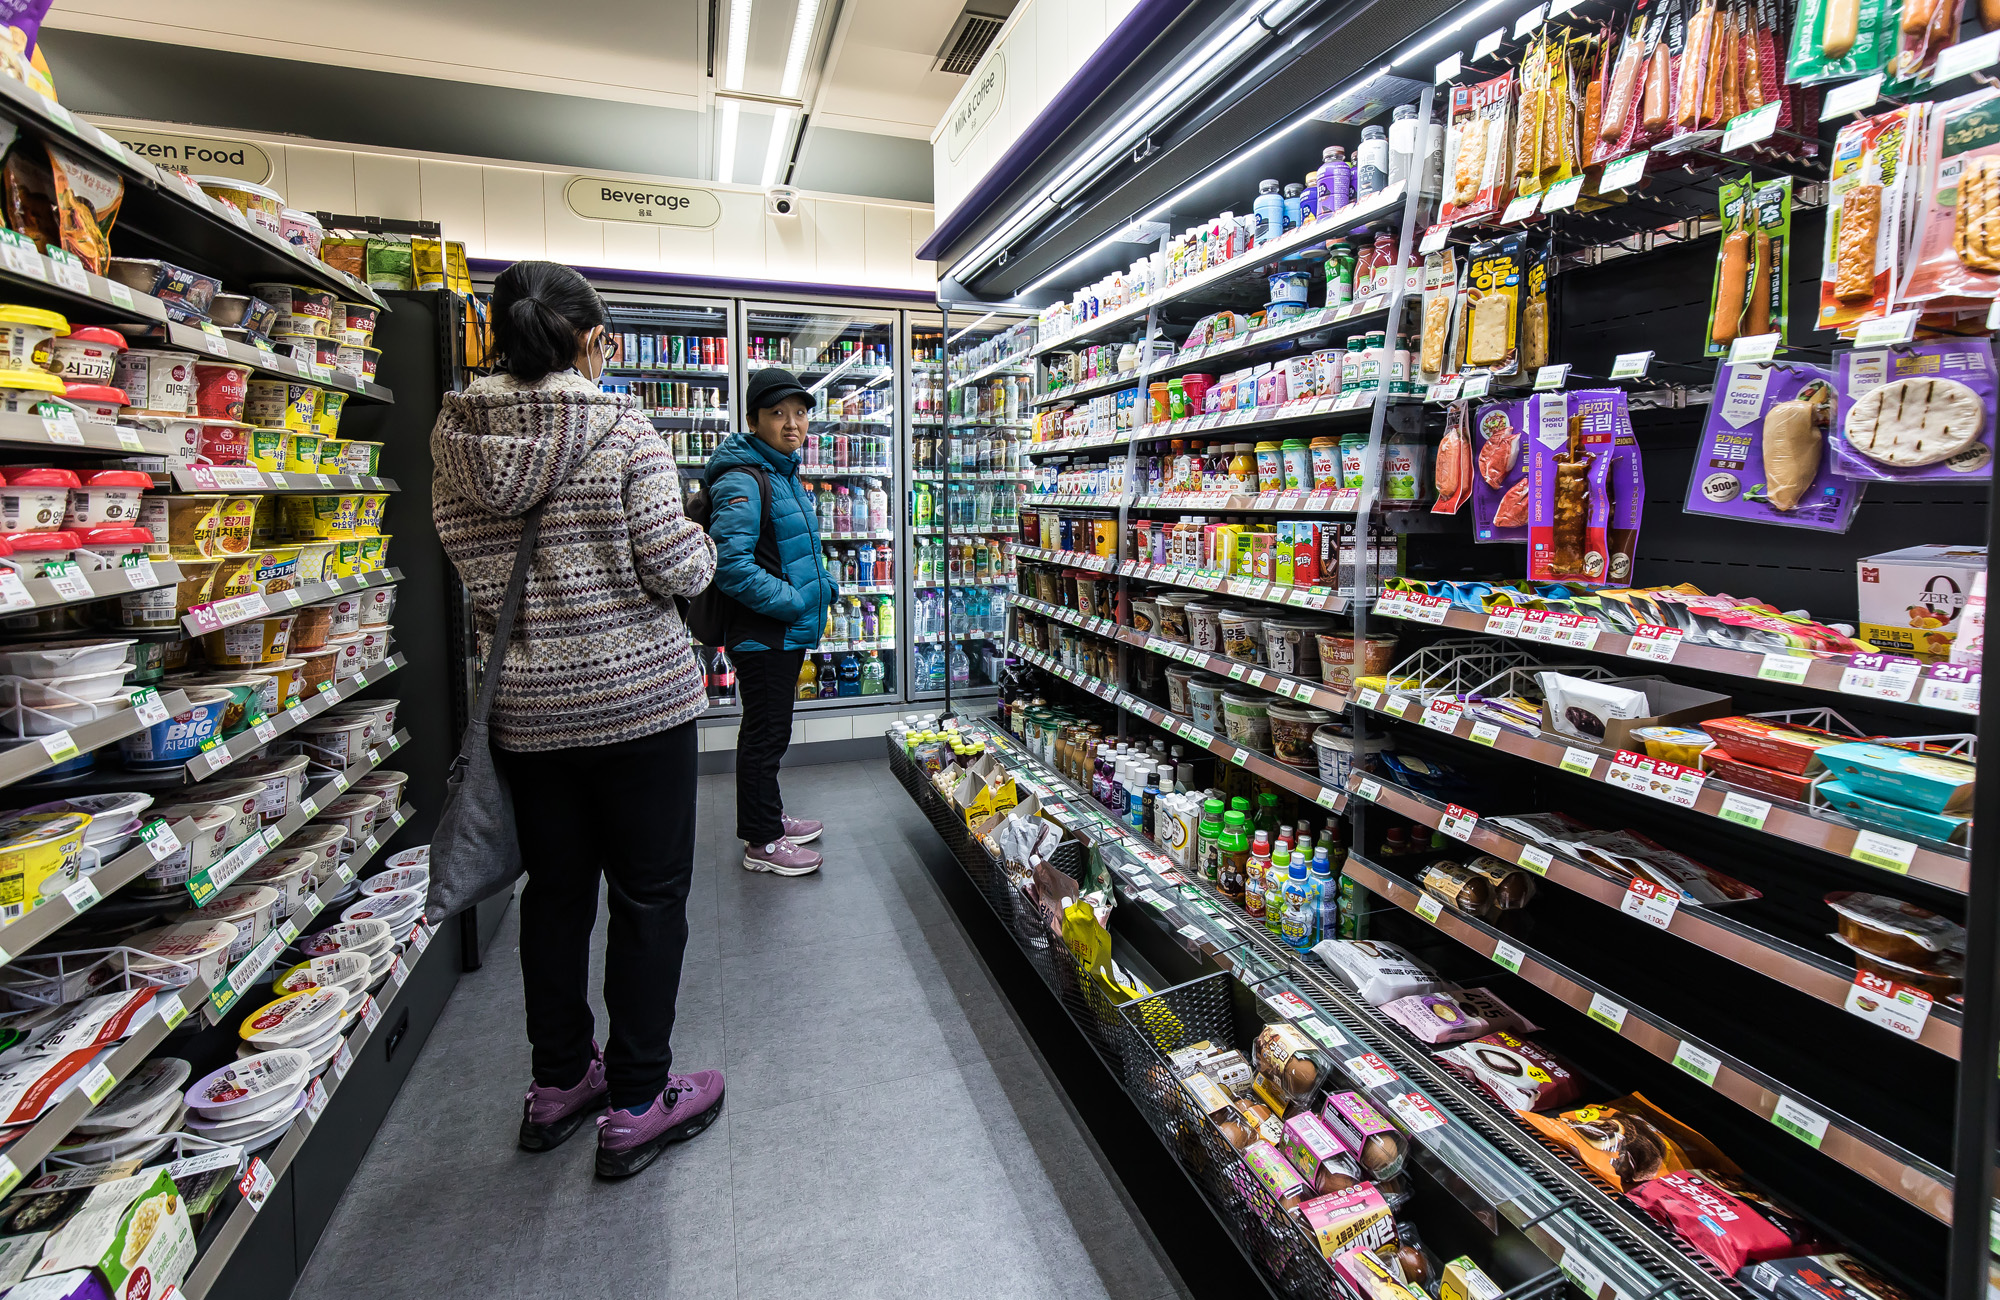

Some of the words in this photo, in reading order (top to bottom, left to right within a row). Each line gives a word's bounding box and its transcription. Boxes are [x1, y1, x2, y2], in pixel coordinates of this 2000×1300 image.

[1472, 78, 1508, 112] BIG
[954, 109, 967, 137] Milk
[972, 71, 995, 112] Coffee
[118, 140, 178, 159] ozen
[184, 145, 245, 166] Food
[601, 187, 690, 210] Beverage
[638, 208, 653, 217] 음료
[180, 272, 194, 284] BIG
[1470, 256, 1514, 290] 탱글
[173, 310, 186, 322] BIG
[1942, 352, 1987, 371] 득템
[65, 361, 111, 379] 쇠고기죽
[1730, 391, 1760, 399] CHOICE
[1748, 398, 1756, 406] U
[1541, 416, 1566, 424] CHOICE
[1557, 421, 1563, 429] U
[1715, 433, 1753, 446] 닭가슴살
[1712, 443, 1750, 461] 득템
[1314, 463, 1332, 473] live
[192, 467, 213, 483] 2+2
[123, 556, 136, 568] 1+1
[46, 564, 64, 578] 1+1
[258, 569, 285, 580] 오뚜기
[1383, 590, 1396, 599] 2+1
[1409, 592, 1421, 602] 2+1
[1424, 596, 1438, 606] 2+1
[194, 608, 216, 624] 2+2
[1494, 606, 1510, 616] 2+1
[1528, 611, 1543, 621] 2+1
[1561, 615, 1577, 625] 2+1
[1638, 624, 1660, 637] 2+1
[1853, 653, 1884, 668] 2+1
[1933, 664, 1969, 681] 2+1
[131, 693, 147, 705] 1+1
[1433, 701, 1448, 711] 2+1
[166, 719, 213, 740] BIG
[1617, 751, 1638, 765] 2+1
[1656, 762, 1679, 777] 2+1
[1448, 804, 1463, 816] 2+1
[140, 828, 157, 841] 1+1
[1633, 879, 1655, 894] 2+1
[1861, 972, 1893, 992] 2+1
[1283, 992, 1298, 1005] 2+1
[1365, 1054, 1384, 1068] 2+1
[1409, 1094, 1430, 1109] 2+1
[1659, 1174, 1740, 1222] 고추잡채
